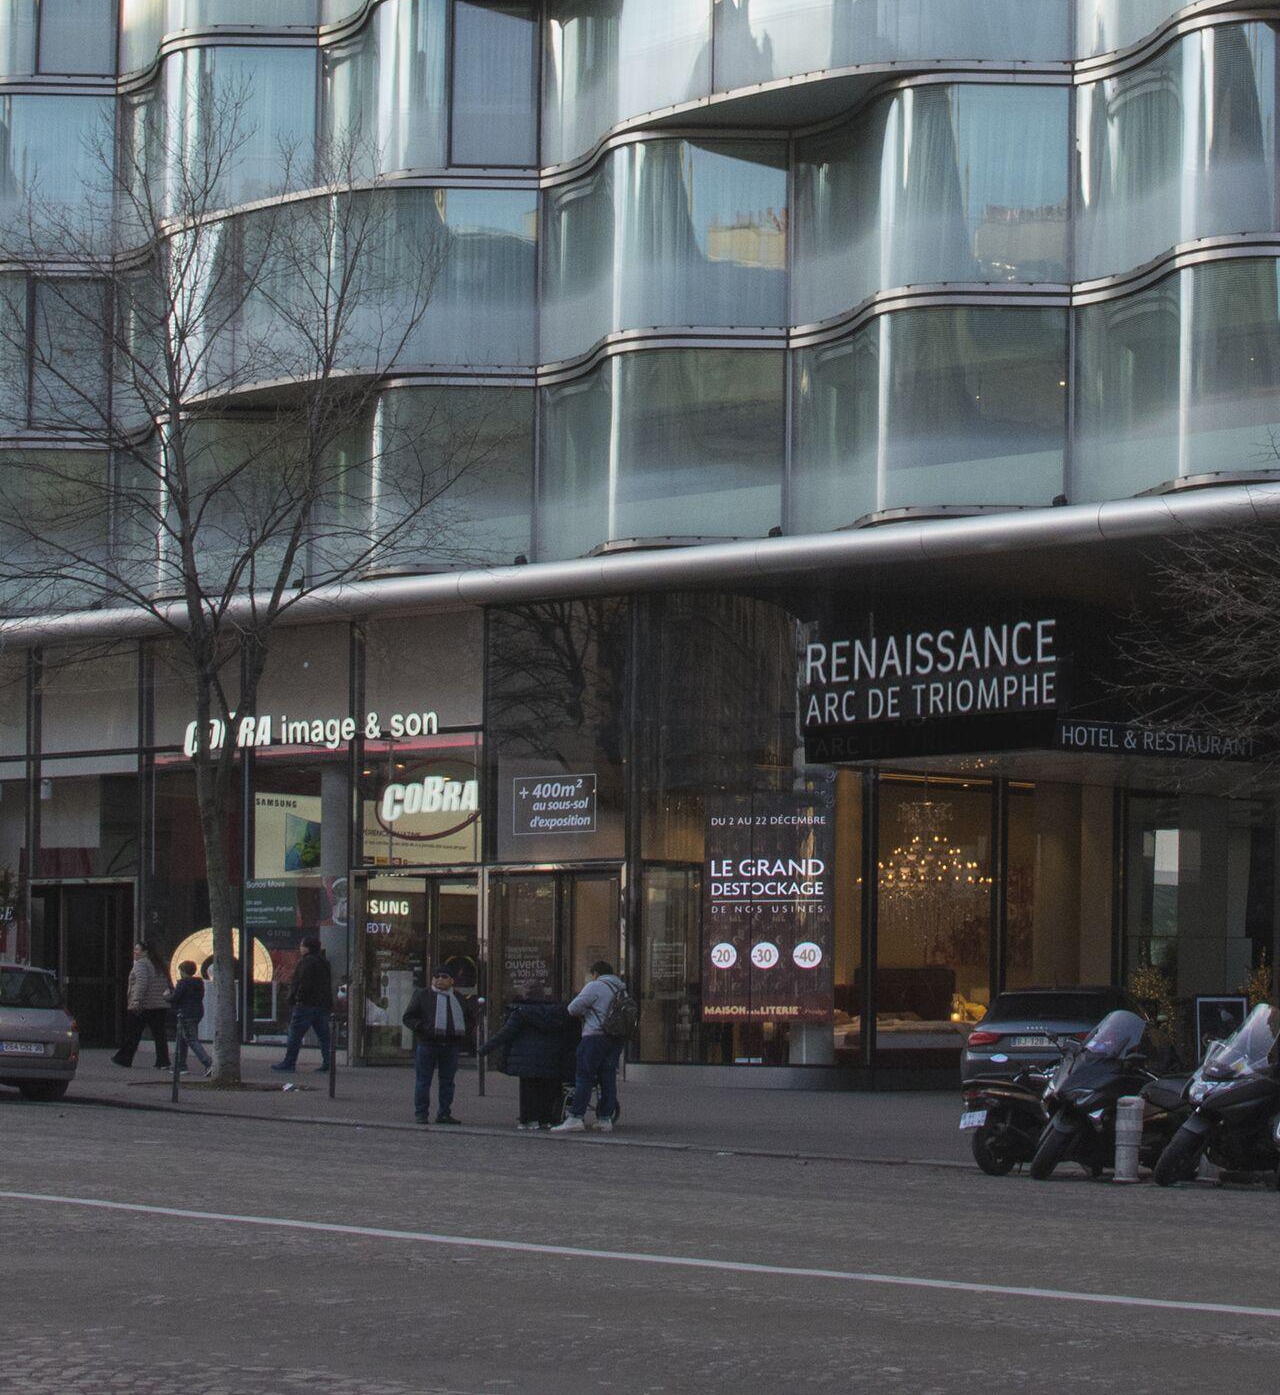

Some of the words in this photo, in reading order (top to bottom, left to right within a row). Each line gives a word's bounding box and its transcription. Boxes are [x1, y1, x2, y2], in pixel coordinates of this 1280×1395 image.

[806, 619, 1057, 684] RENAISSANCE
[806, 690, 856, 725] ARC
[868, 687, 900, 719] DE
[912, 672, 1056, 716] TRIOMPHE
[184, 712, 271, 757] CORA
[281, 716, 356, 749] image
[365, 711, 381, 740] &
[391, 710, 438, 737] son
[1061, 725, 1119, 748] HOTEL
[1124, 730, 1137, 749] &
[1143, 731, 1254, 755] RESTAURANT
[255, 798, 298, 808] SAMSUNG
[532, 801, 547, 811] au
[548, 796, 590, 811] sous-sol
[529, 814, 592, 830] d'exposition
[711, 816, 726, 826] DU
[728, 816, 735, 826] 2
[736, 816, 752, 825] AU
[755, 816, 767, 825] 22
[769, 813, 827, 825] DÉCEMBRE
[710, 859, 734, 877] LE
[739, 858, 825, 877] GRAND
[711, 881, 825, 896] DESTOCKAGE
[367, 899, 410, 916] SUNG
[711, 905, 727, 914] DE
[734, 905, 763, 914] NOS
[704, 1005, 746, 1015] MAISON
[760, 1005, 800, 1015] LITERIE
